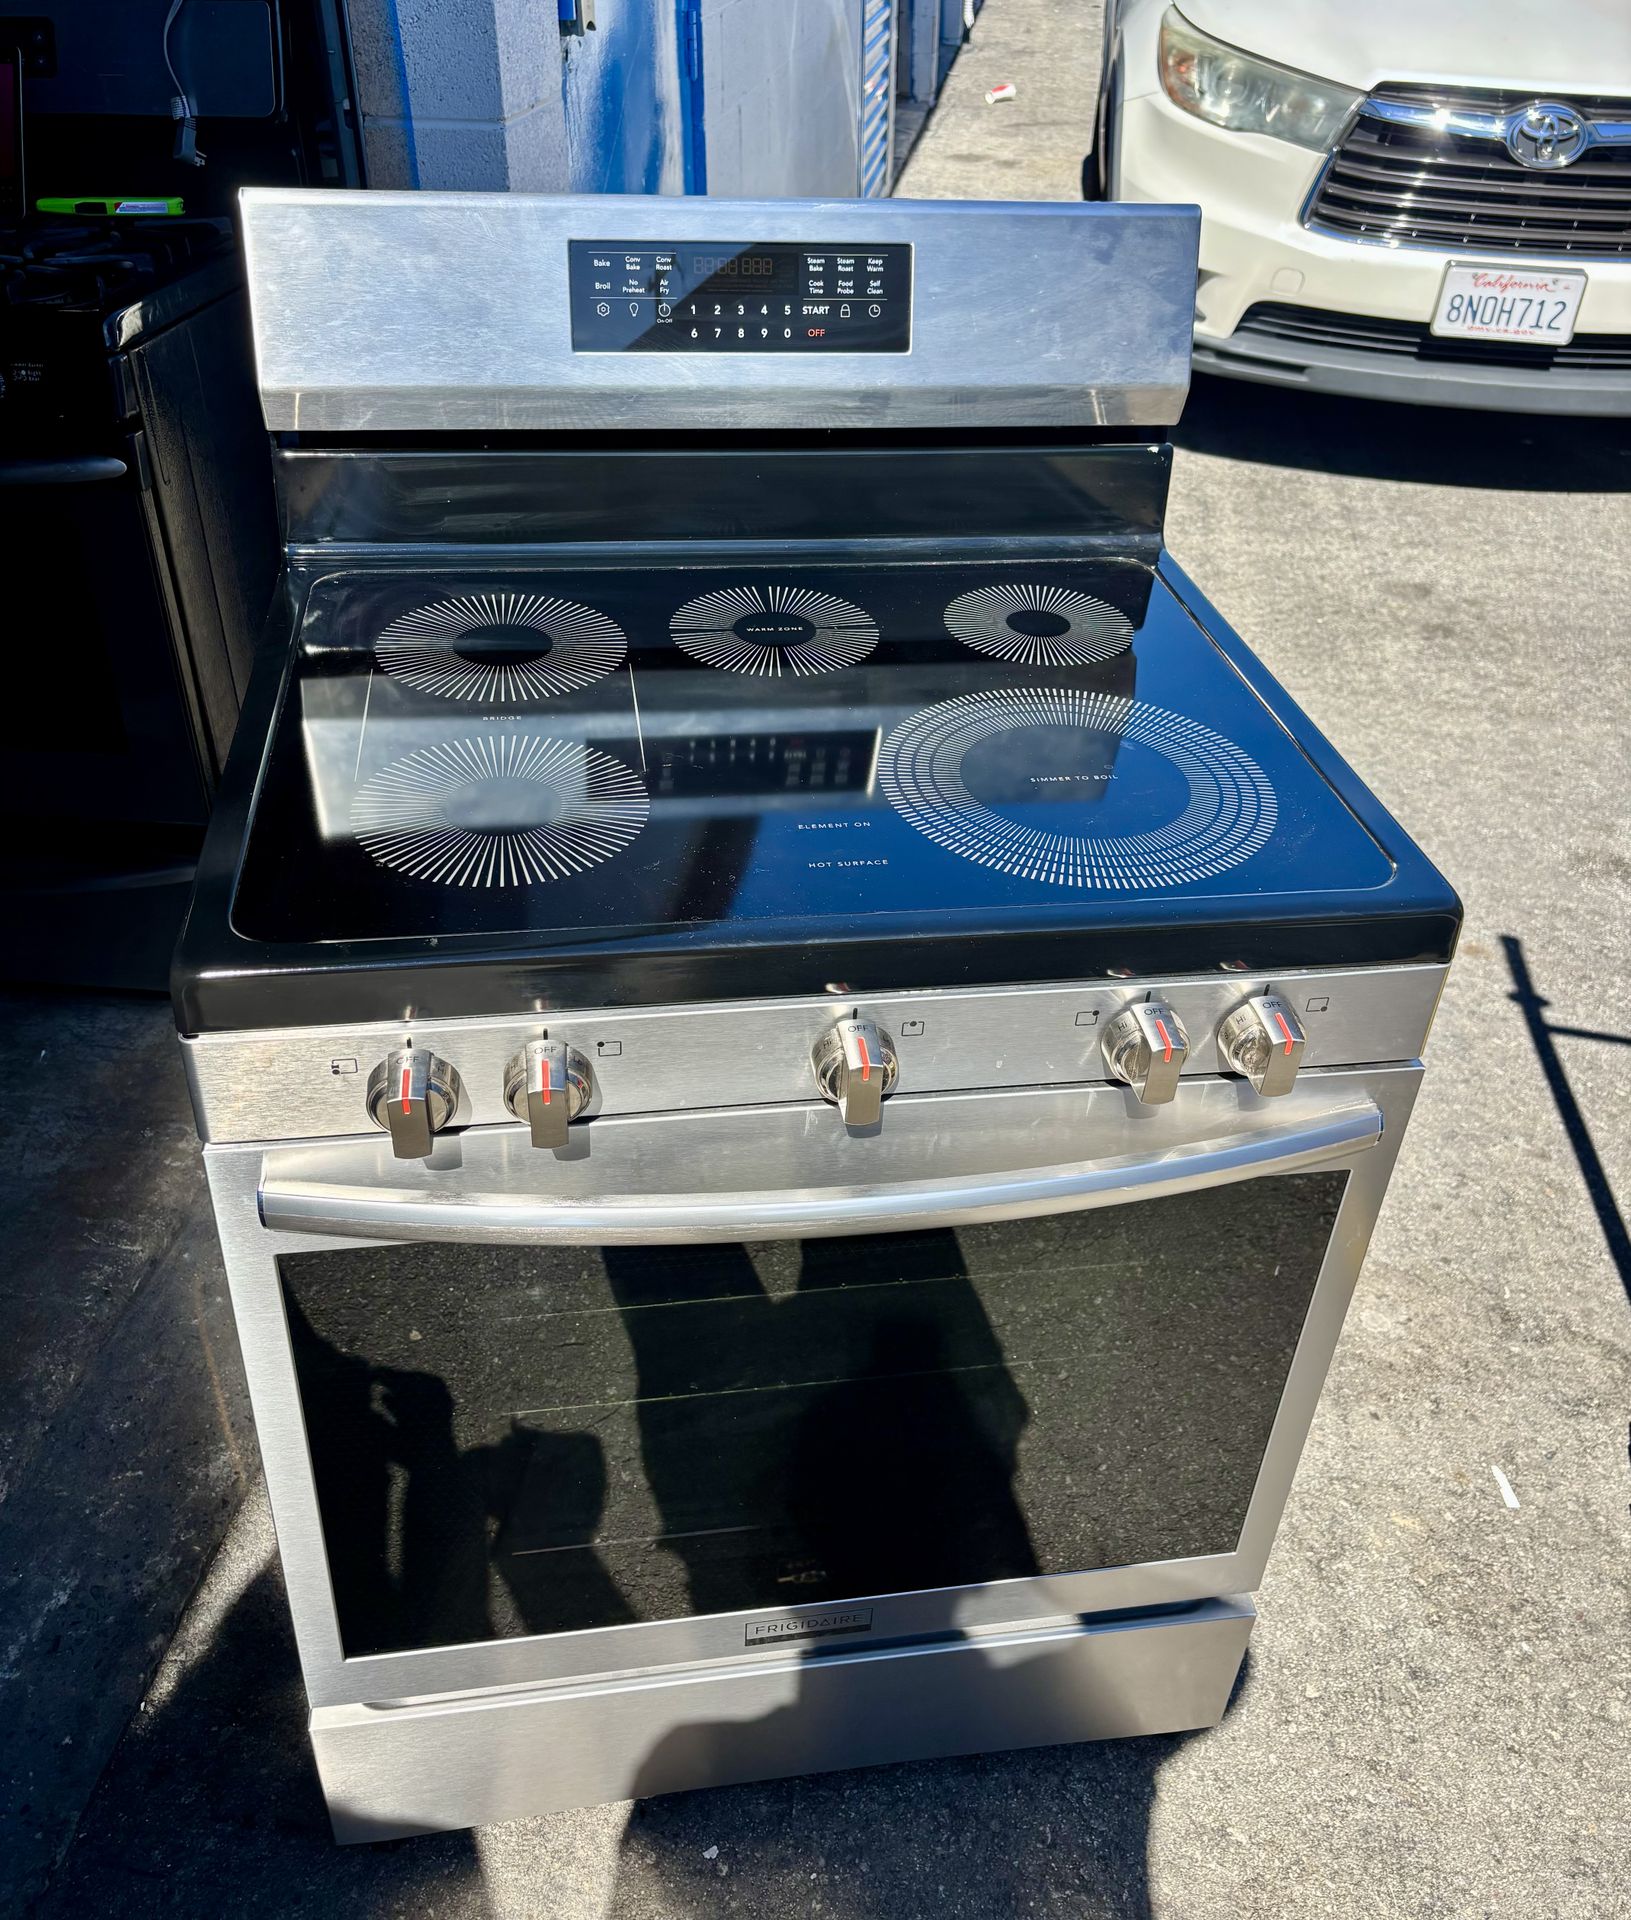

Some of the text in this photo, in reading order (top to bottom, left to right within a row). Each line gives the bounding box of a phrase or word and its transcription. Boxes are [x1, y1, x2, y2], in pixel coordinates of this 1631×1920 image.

[594, 259, 610, 267] Bake
[1474, 272, 1555, 293] California
[660, 286, 669, 294] Fry
[690, 305, 791, 315] 1 2 3 4 5
[802, 306, 830, 314] START
[1446, 294, 1567, 330] 8NOH712
[691, 328, 791, 338] 6 7 8 9 0
[1236, 1015, 1246, 1024] Hi
[1118, 1021, 1128, 1031] Hi
[535, 1046, 557, 1054] OFF
[755, 1614, 864, 1635] FRIGIDAIRE
